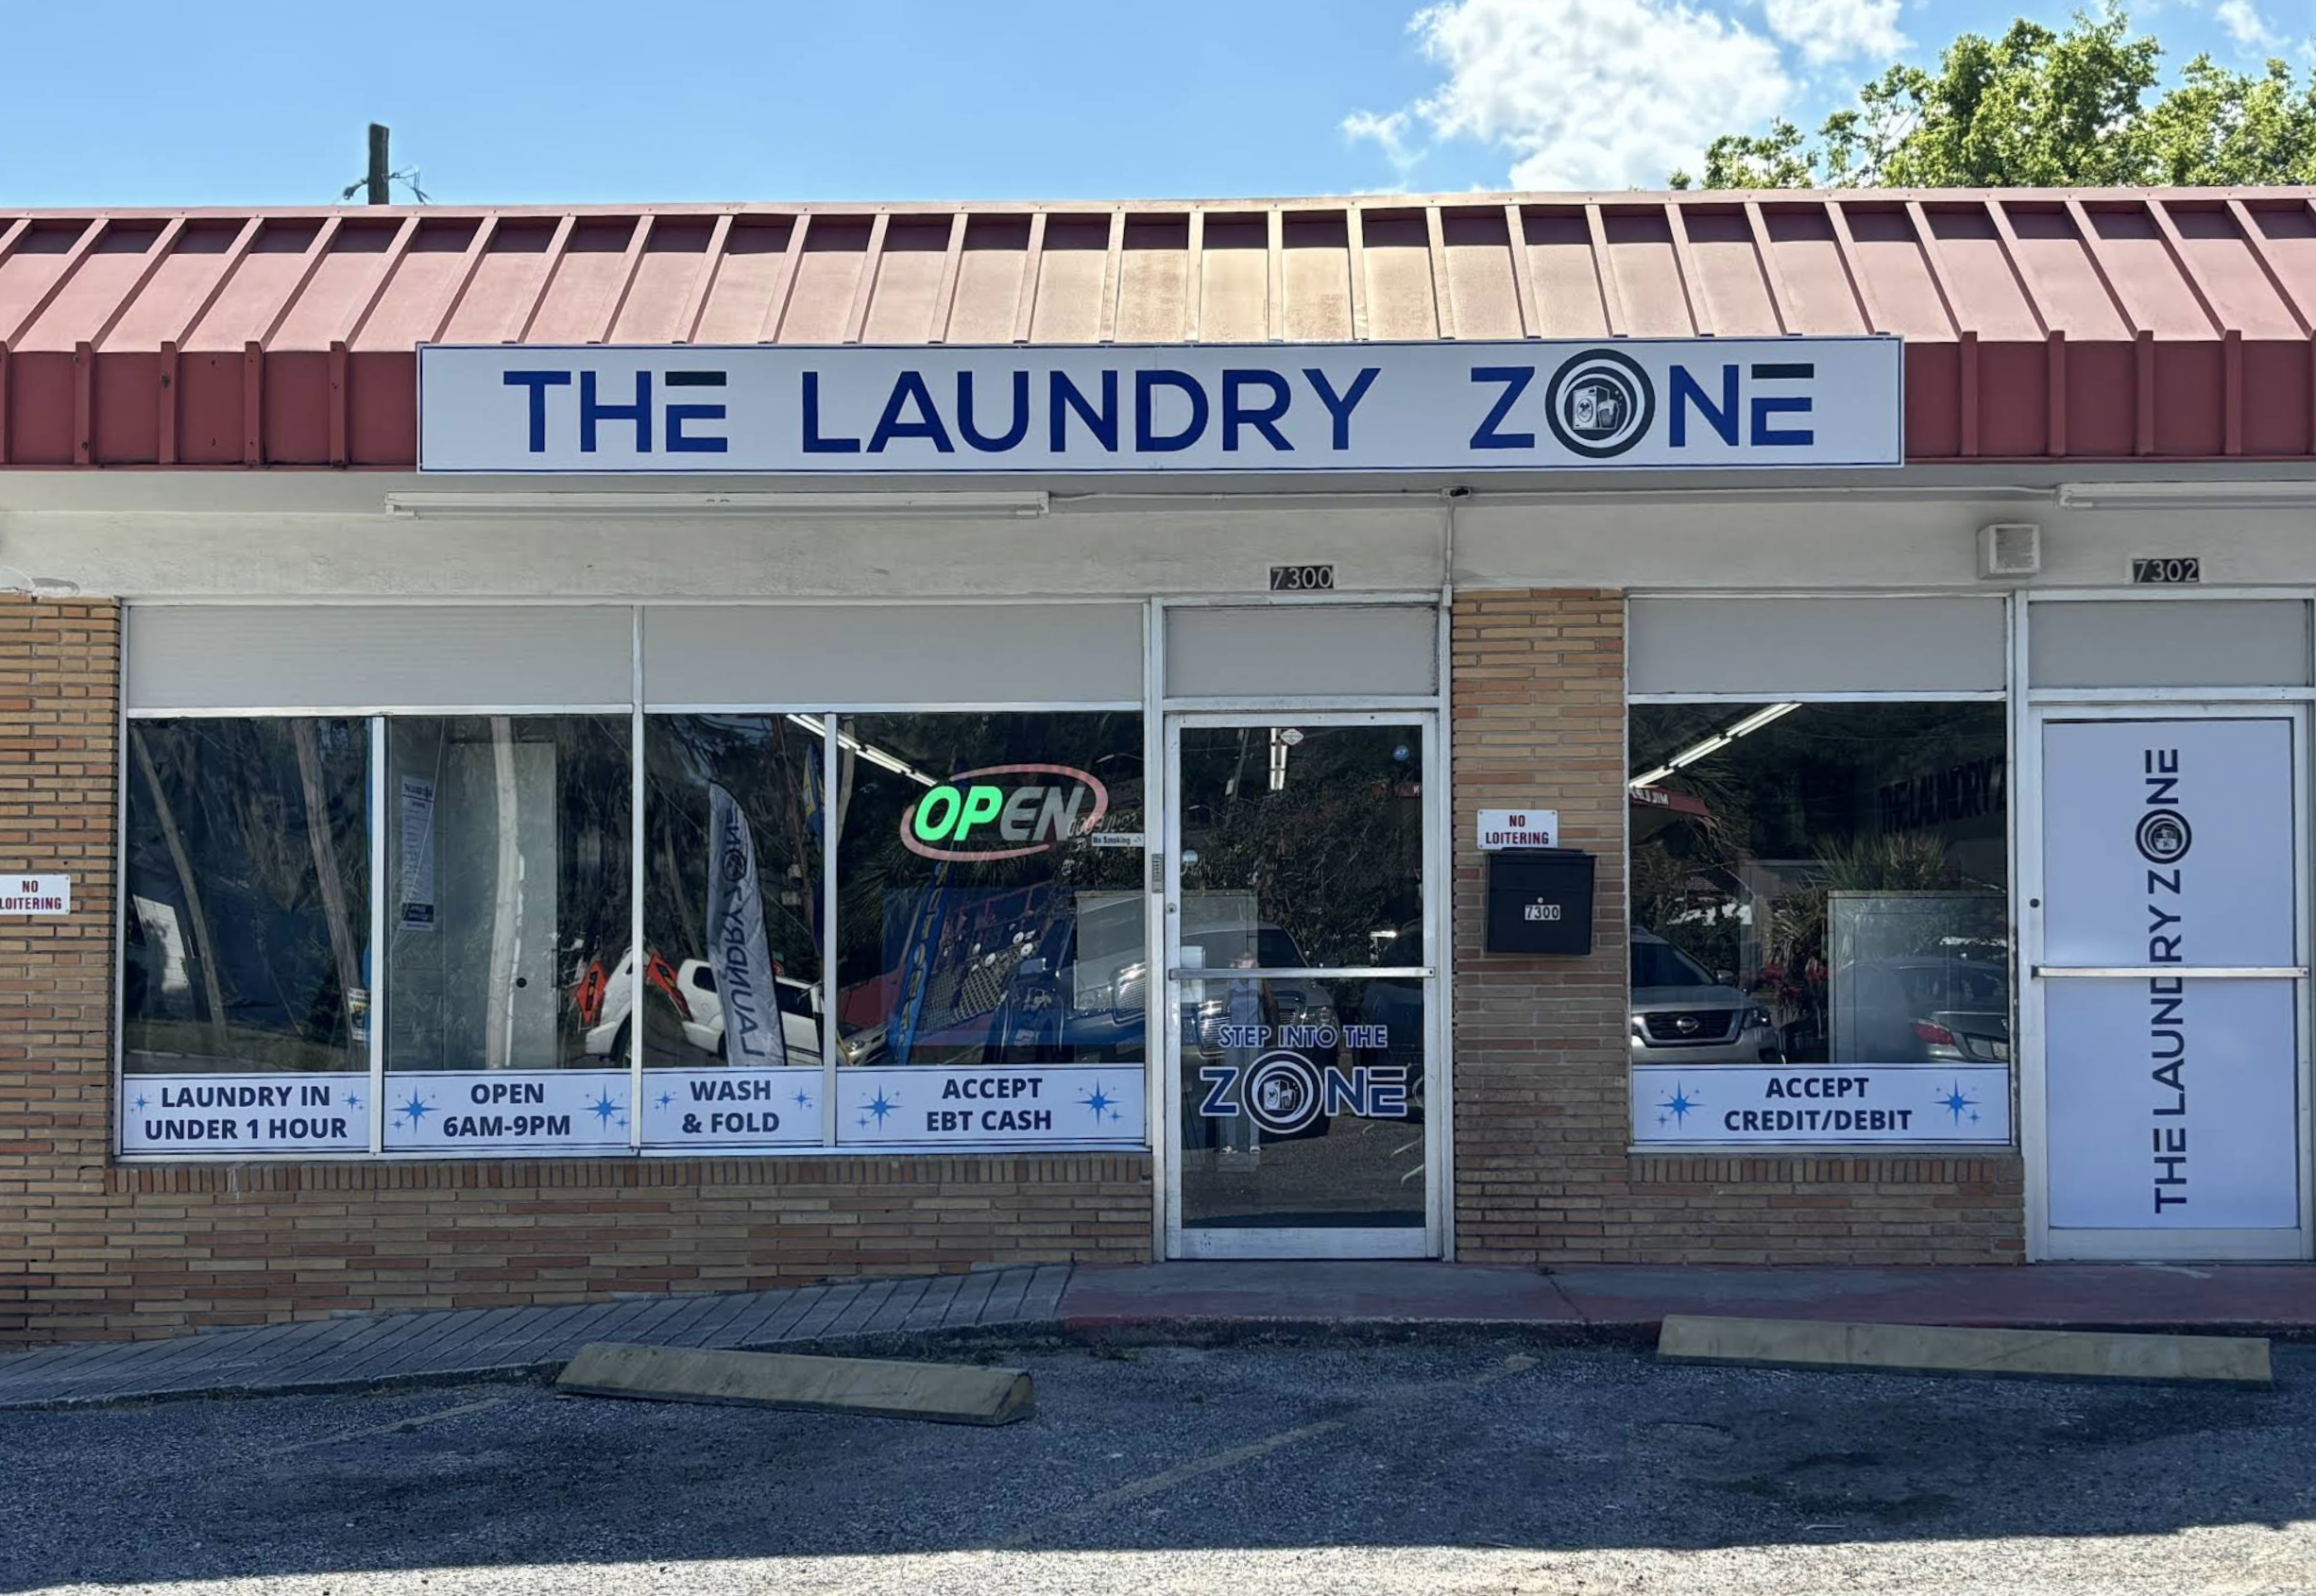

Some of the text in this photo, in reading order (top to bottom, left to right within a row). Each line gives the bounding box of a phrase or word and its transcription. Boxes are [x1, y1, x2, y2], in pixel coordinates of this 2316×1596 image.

[503, 348, 1814, 459] THE LAUNDRY ZONE
[1270, 566, 1333, 590] 7300
[2135, 559, 2198, 583] 7302
[914, 786, 1087, 841] OPEN
[1509, 815, 1526, 828] NO
[1486, 832, 1549, 845] LOITERING
[22, 880, 39, 893] NO
[1525, 907, 1560, 919] 7300
[2135, 749, 2192, 1214] THE LAUNDRY ZONE
[1218, 1025, 1388, 1048] STEP INTO THE
[162, 1086, 331, 1108] LAUNDRY IN
[470, 1083, 544, 1104] OPEN
[690, 1080, 771, 1102] WASH
[942, 1078, 1043, 1099] ACCEPT
[1200, 1050, 1408, 1133] ZONE
[1765, 1078, 1869, 1098] ACCEPT
[145, 1118, 348, 1140] UNDER 1 HOUR
[443, 1115, 570, 1137] 6AM-9PM
[682, 1112, 780, 1134] & FOLD
[927, 1111, 1051, 1132] EBT CASH
[1724, 1110, 1913, 1131] CREDIT/DEBIT
